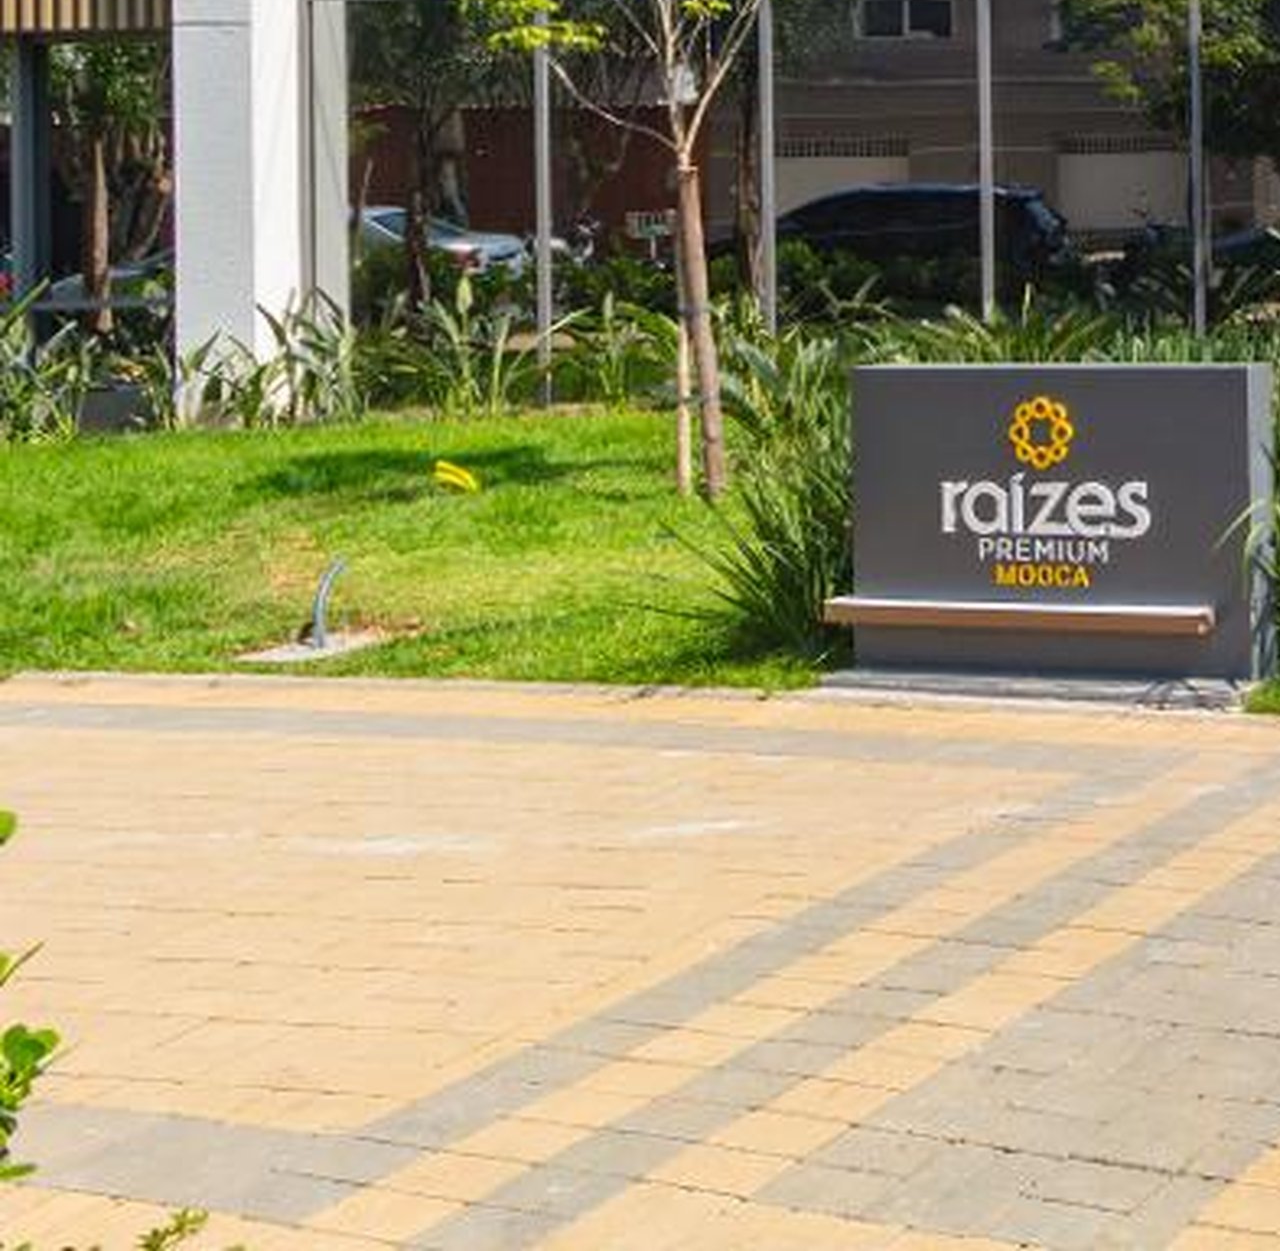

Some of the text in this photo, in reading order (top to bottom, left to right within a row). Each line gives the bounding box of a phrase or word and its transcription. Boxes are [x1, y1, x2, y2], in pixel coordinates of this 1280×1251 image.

[940, 471, 1152, 538] raízes
[978, 538, 1109, 563] PREMIUM
[994, 564, 1090, 587] MOOCA
